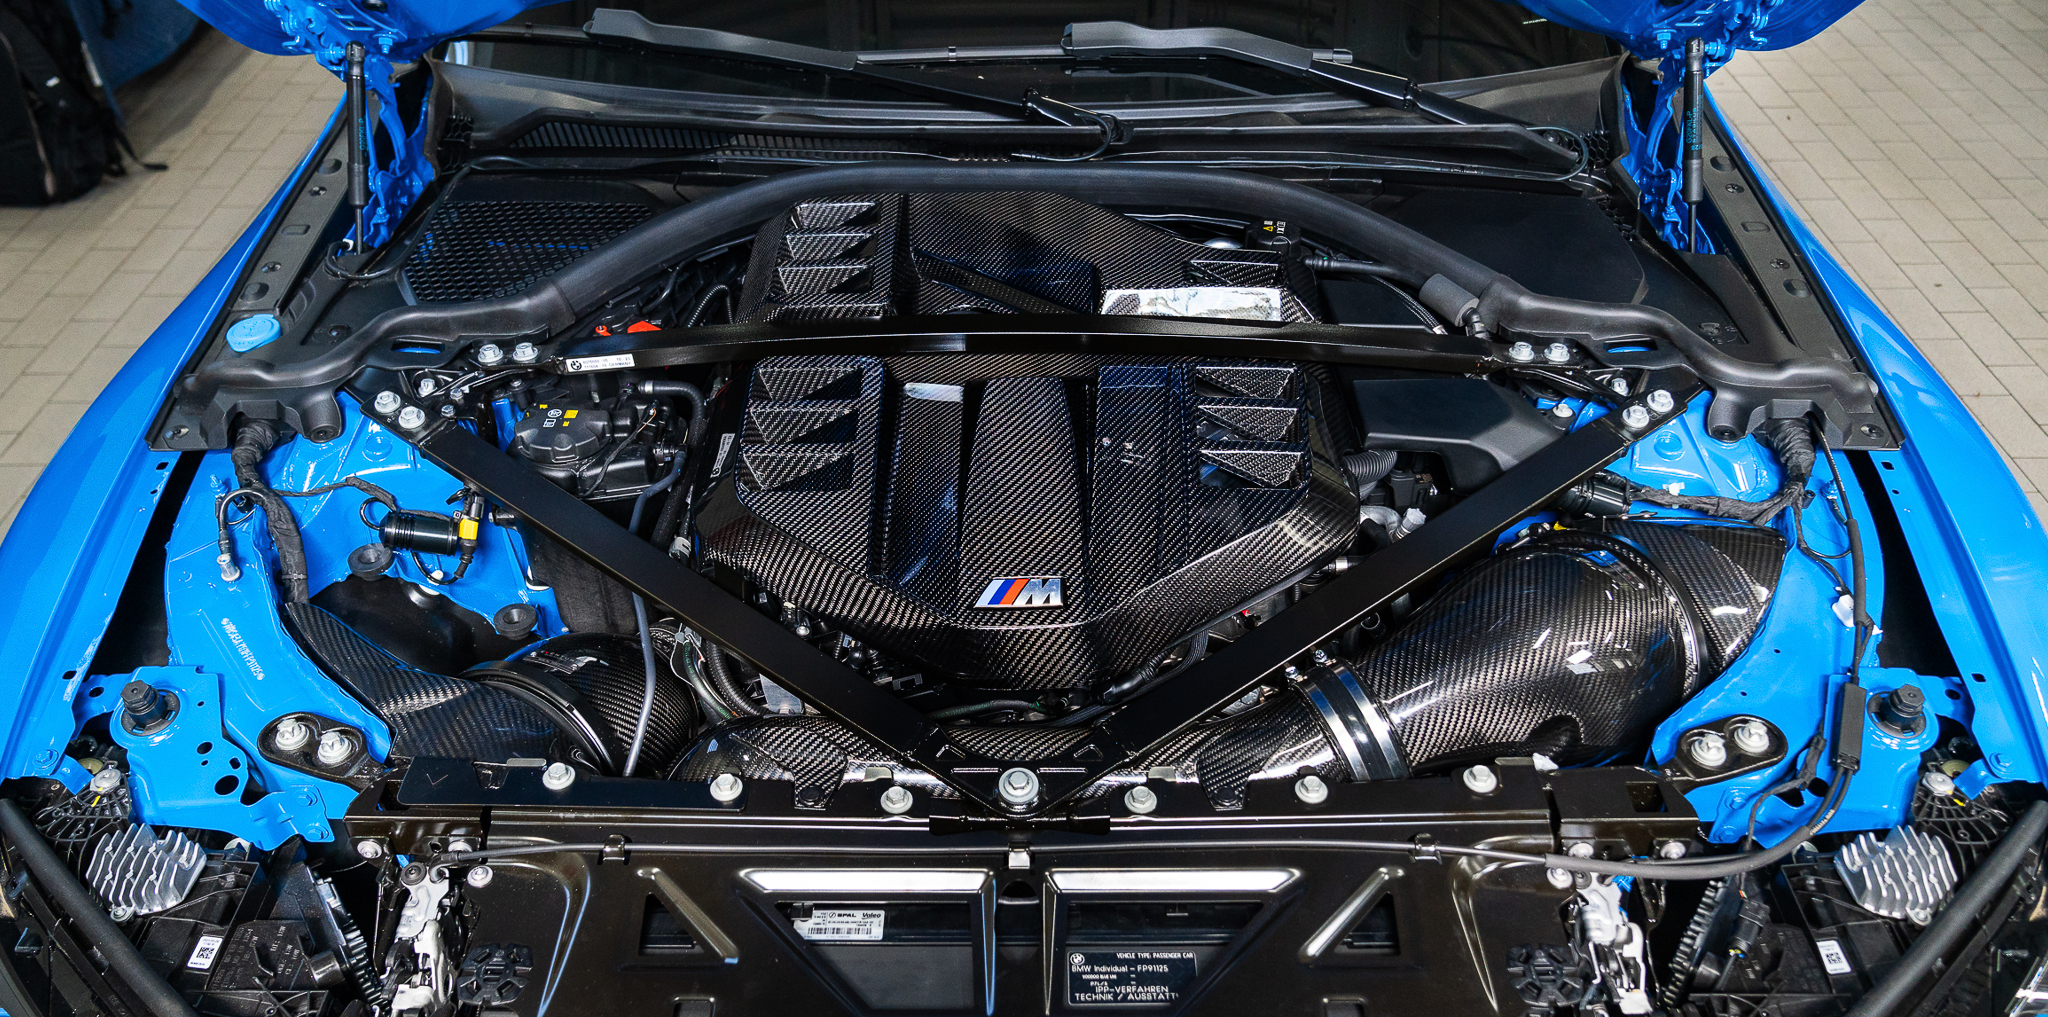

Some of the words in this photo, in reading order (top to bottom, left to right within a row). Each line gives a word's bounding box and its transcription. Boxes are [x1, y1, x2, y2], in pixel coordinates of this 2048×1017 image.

[1012, 578, 1062, 606] M
[1071, 964, 1092, 972] BMW
[1093, 964, 1128, 972] Individual
[1137, 964, 1169, 972] FP91125
[1075, 992, 1114, 1001] TECHNIK
[1127, 992, 1179, 1001] AUSSTATT
